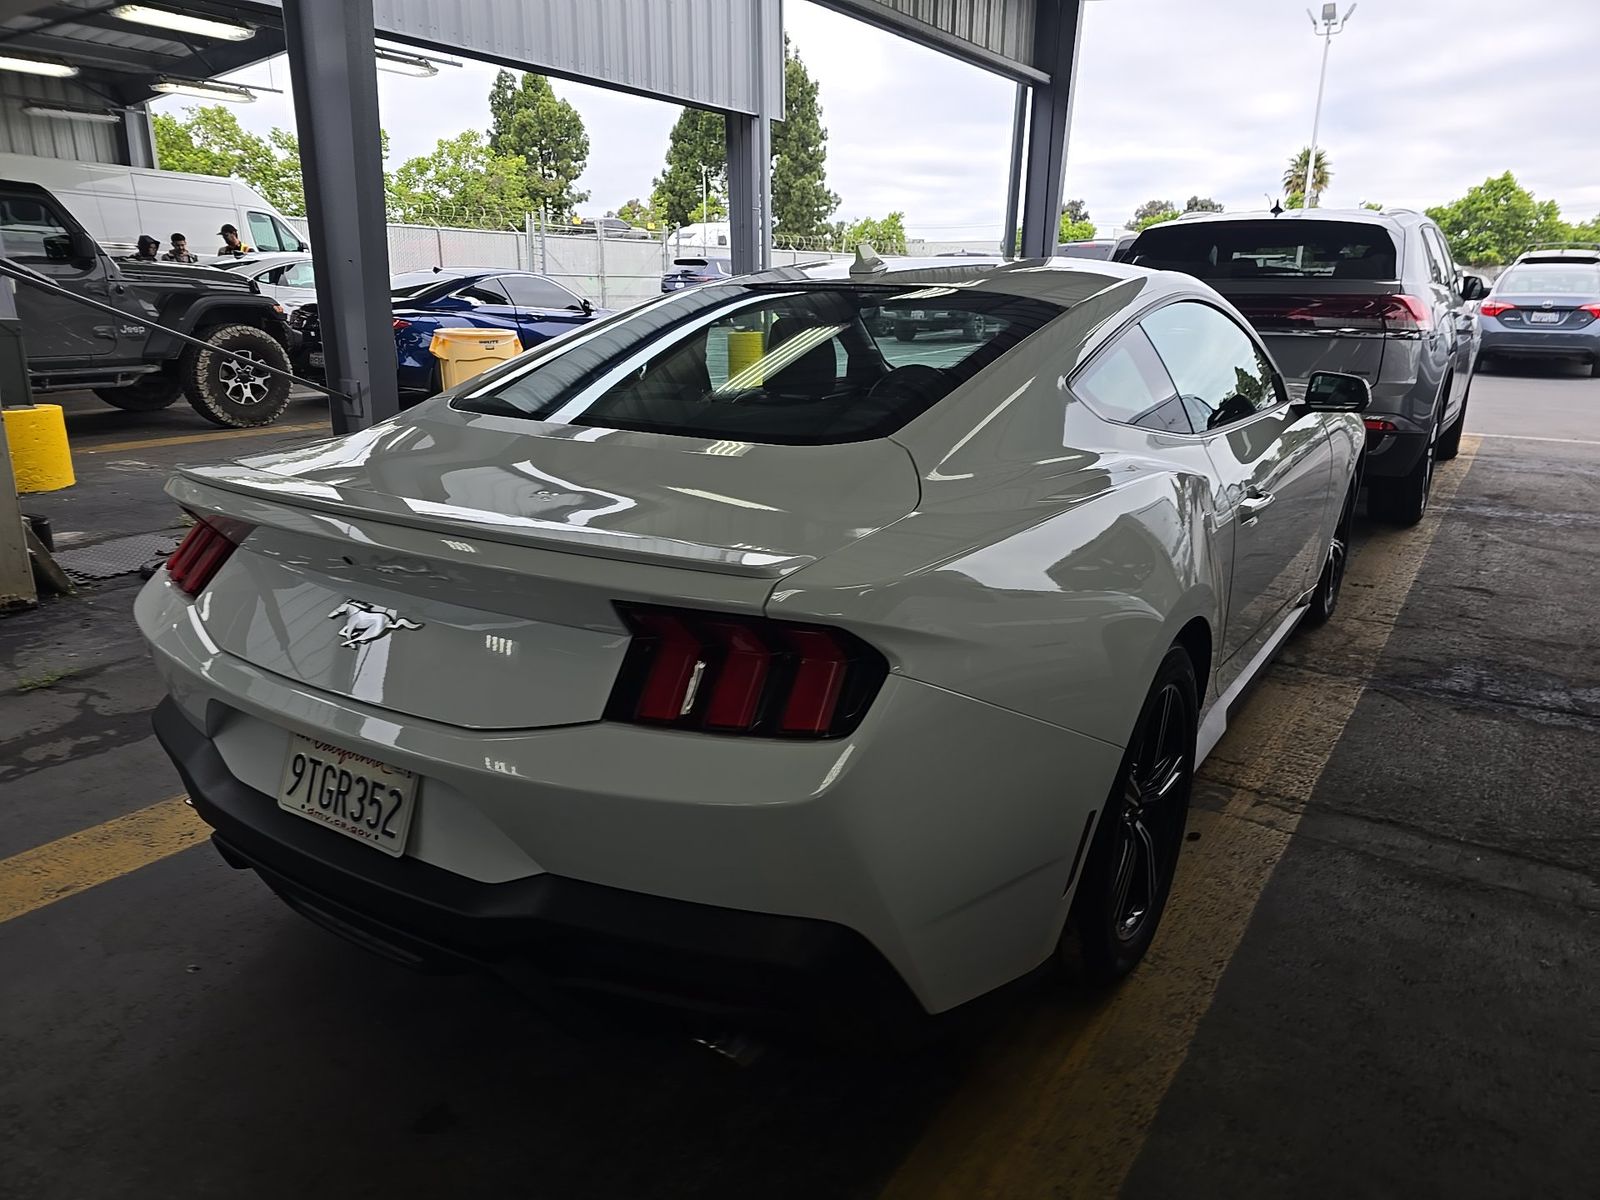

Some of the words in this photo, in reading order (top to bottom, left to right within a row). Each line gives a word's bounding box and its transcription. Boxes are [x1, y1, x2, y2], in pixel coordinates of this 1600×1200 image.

[120, 325, 145, 334] Jeep
[286, 753, 403, 838] 9TGR352
[307, 807, 372, 838] dmv.ca.gov
